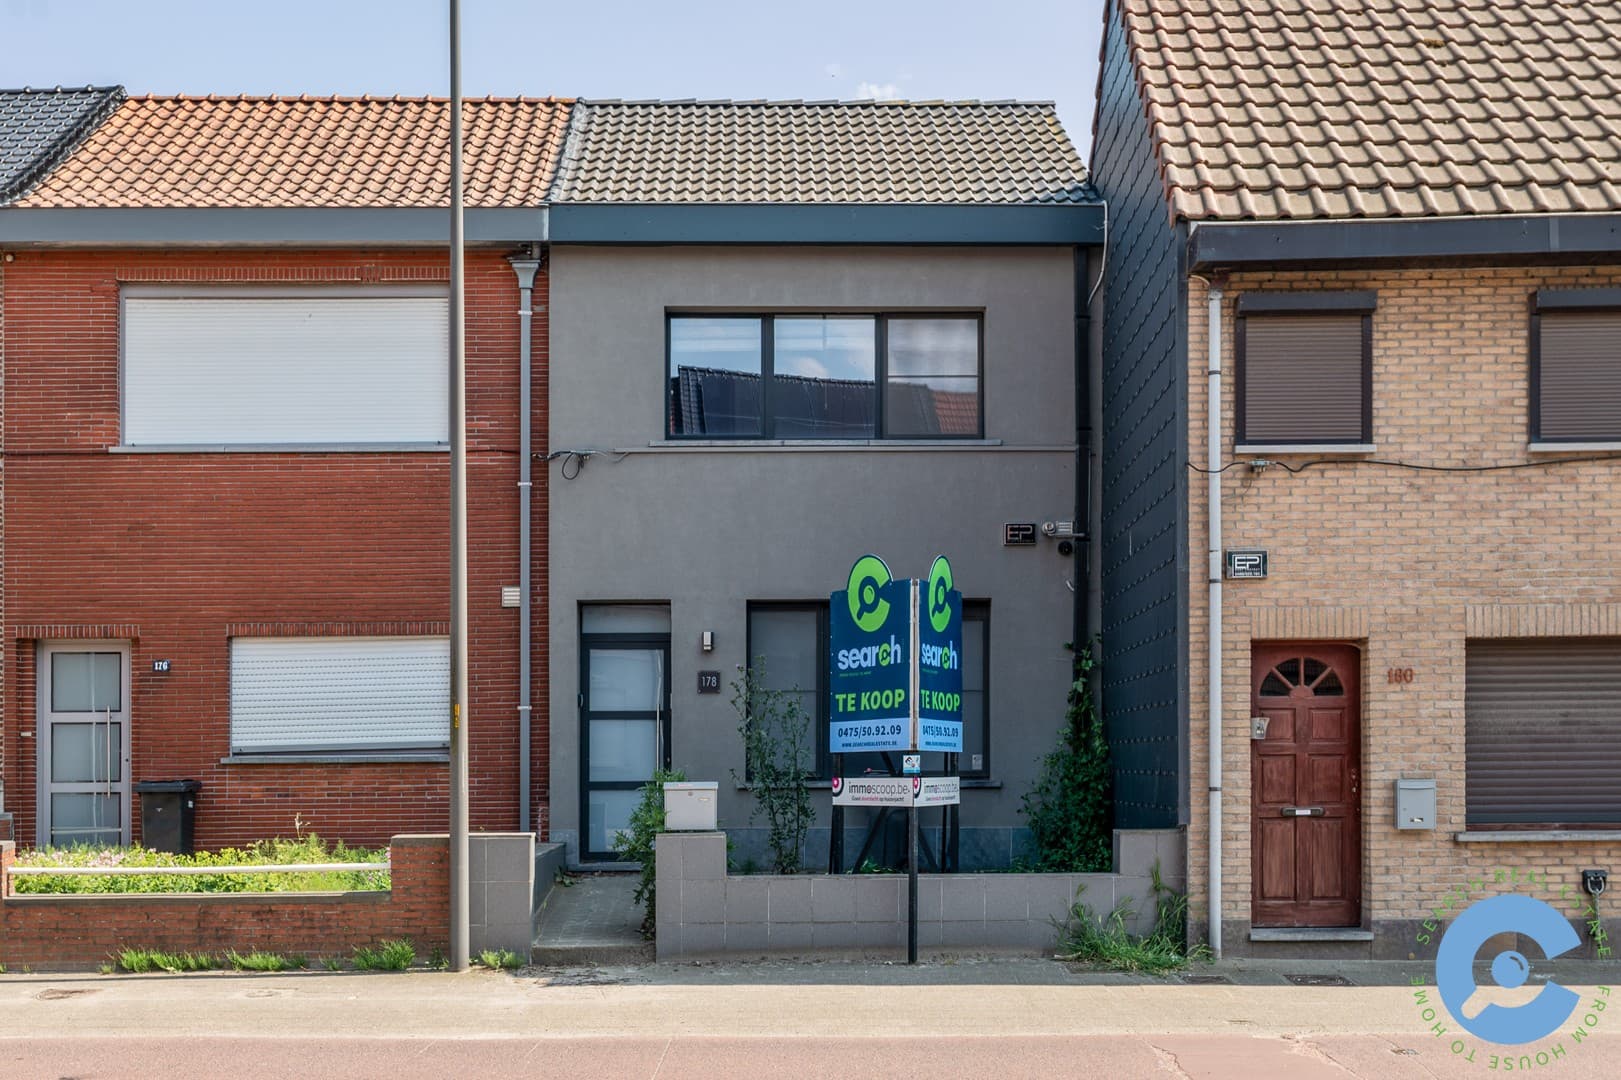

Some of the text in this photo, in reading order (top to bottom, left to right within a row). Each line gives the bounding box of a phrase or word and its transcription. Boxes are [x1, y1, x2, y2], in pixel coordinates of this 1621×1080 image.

[1234, 556, 1260, 569] EP
[837, 634, 902, 671] search
[921, 640, 958, 671] search
[154, 661, 168, 671] 176
[701, 676, 717, 687] 178
[835, 688, 905, 713] TE KOOP
[920, 688, 961, 712] TE KOOP
[837, 724, 902, 739] 0475/50.92.09
